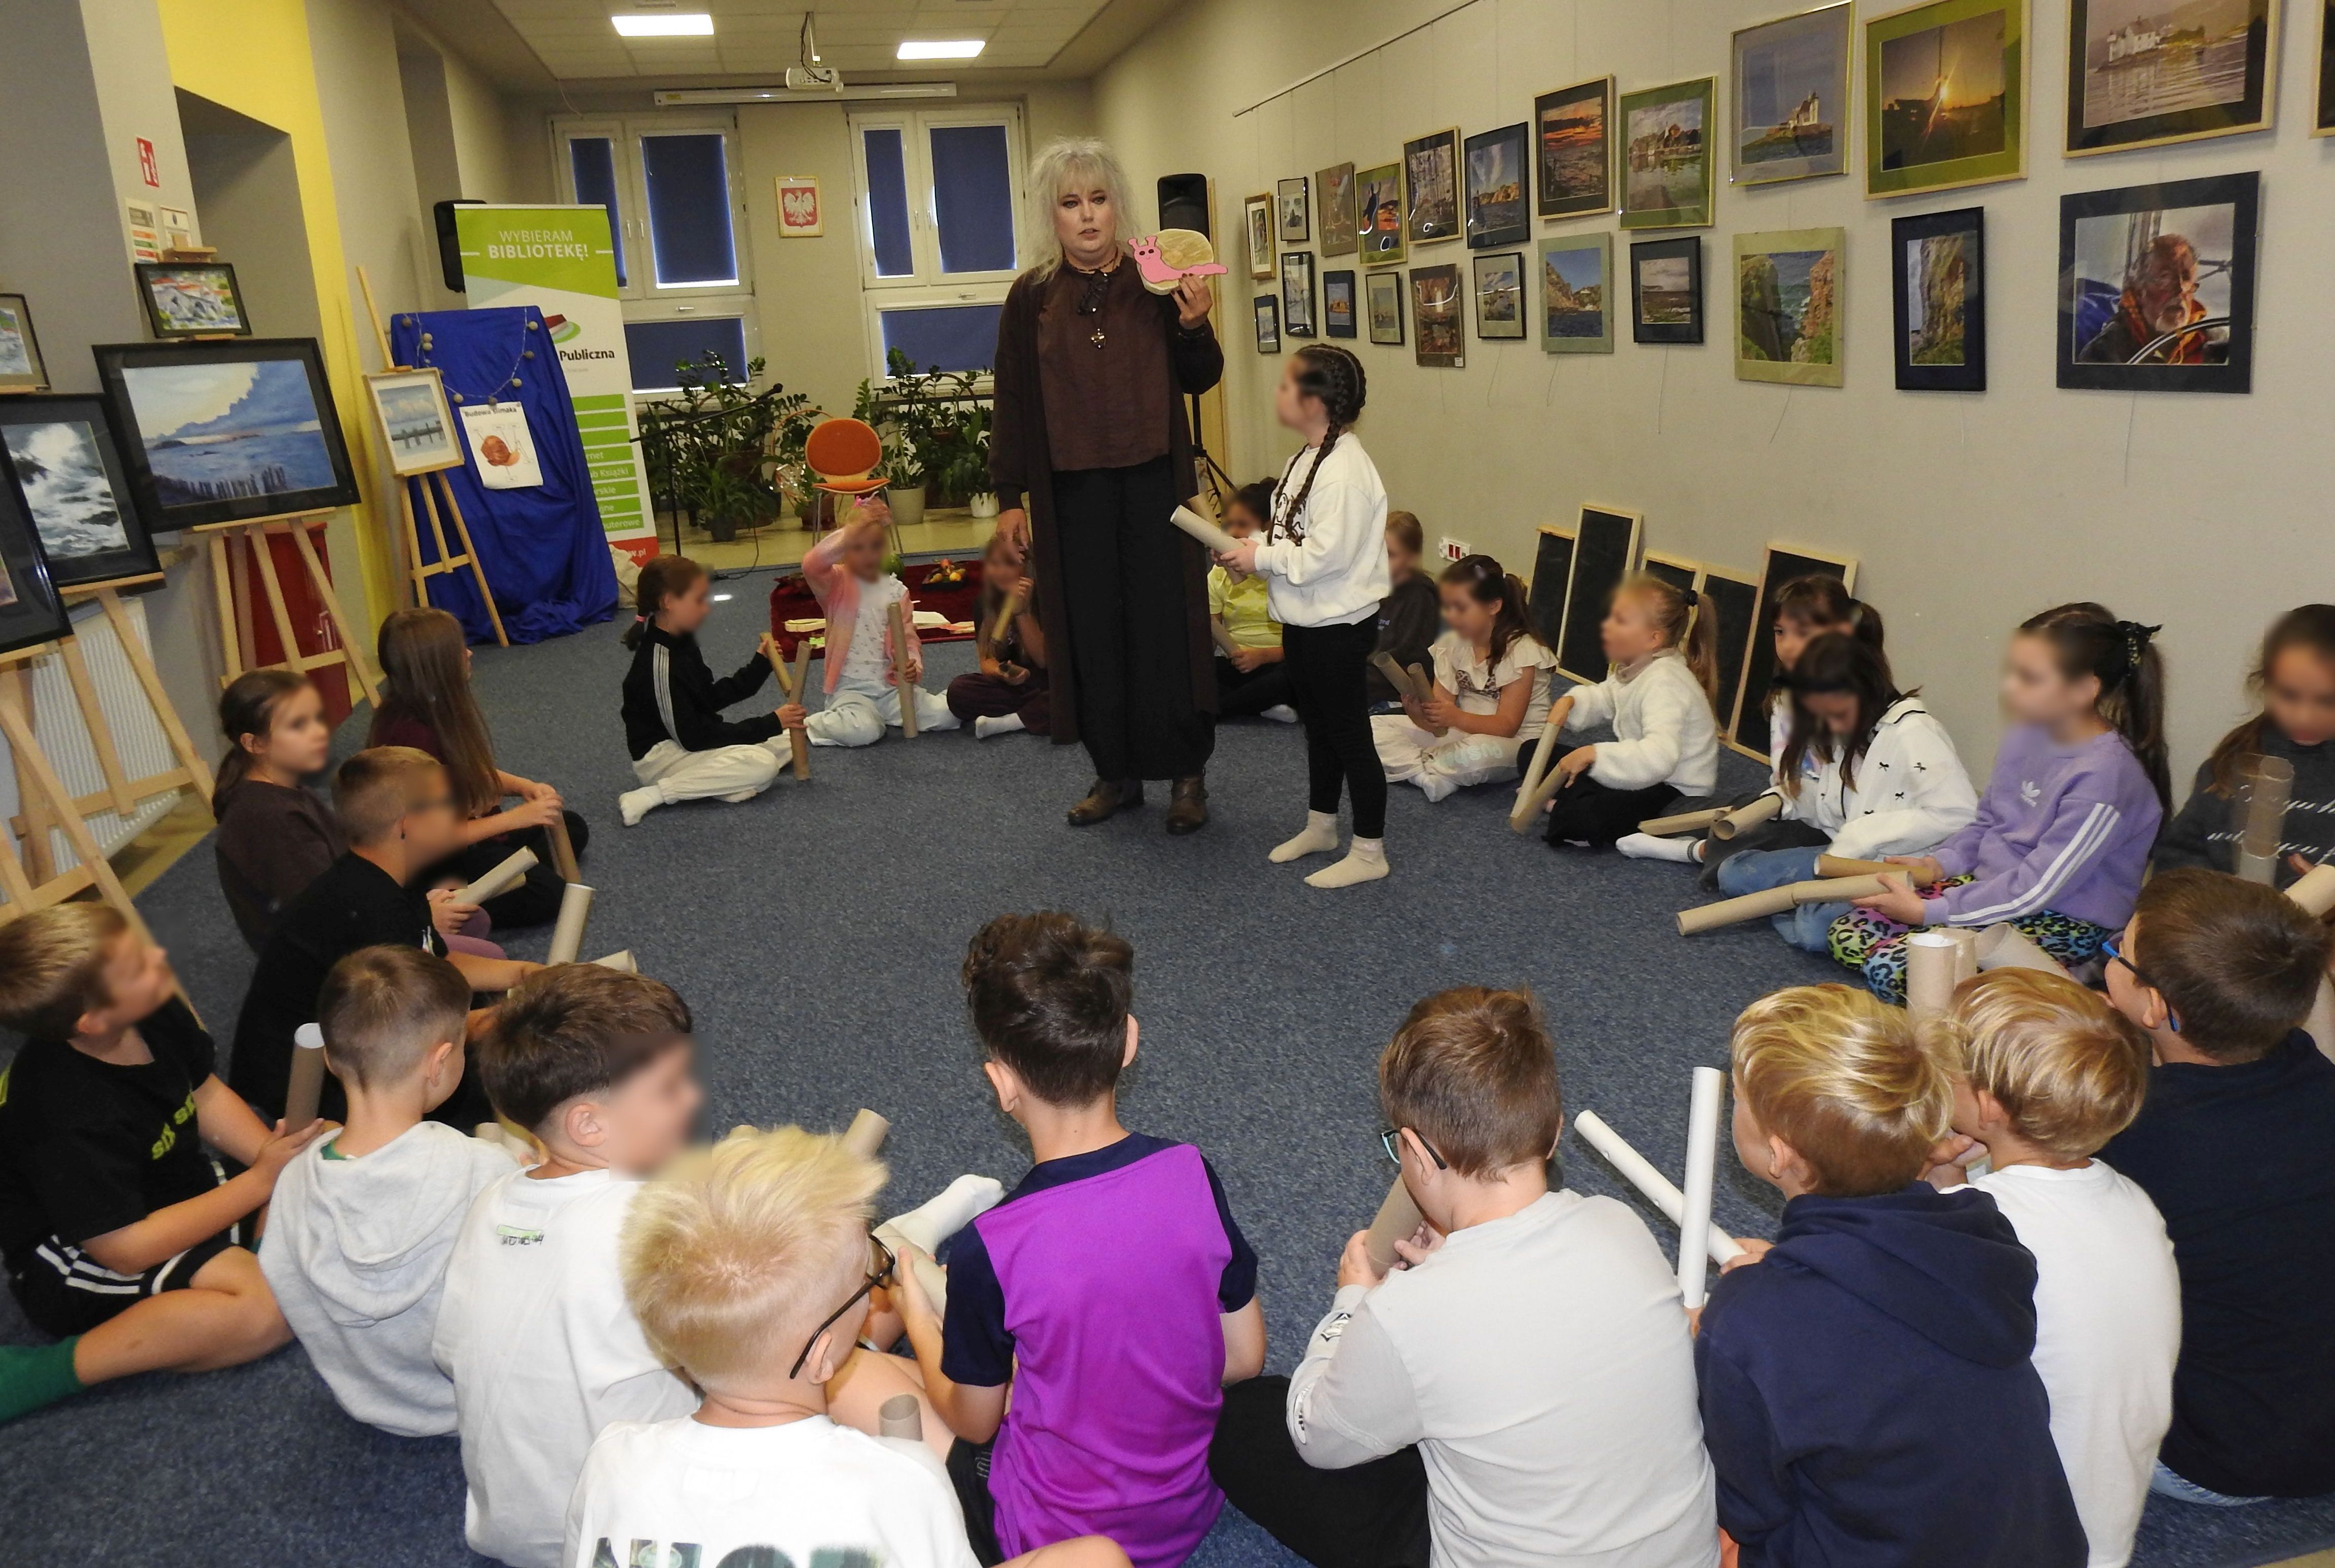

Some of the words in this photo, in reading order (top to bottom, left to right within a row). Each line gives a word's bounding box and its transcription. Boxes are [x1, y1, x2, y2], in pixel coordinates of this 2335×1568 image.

[499, 230, 573, 243] WYBIERAM
[488, 244, 588, 261] BIBLIOTEKĘ!
[559, 349, 615, 361] Publiczna
